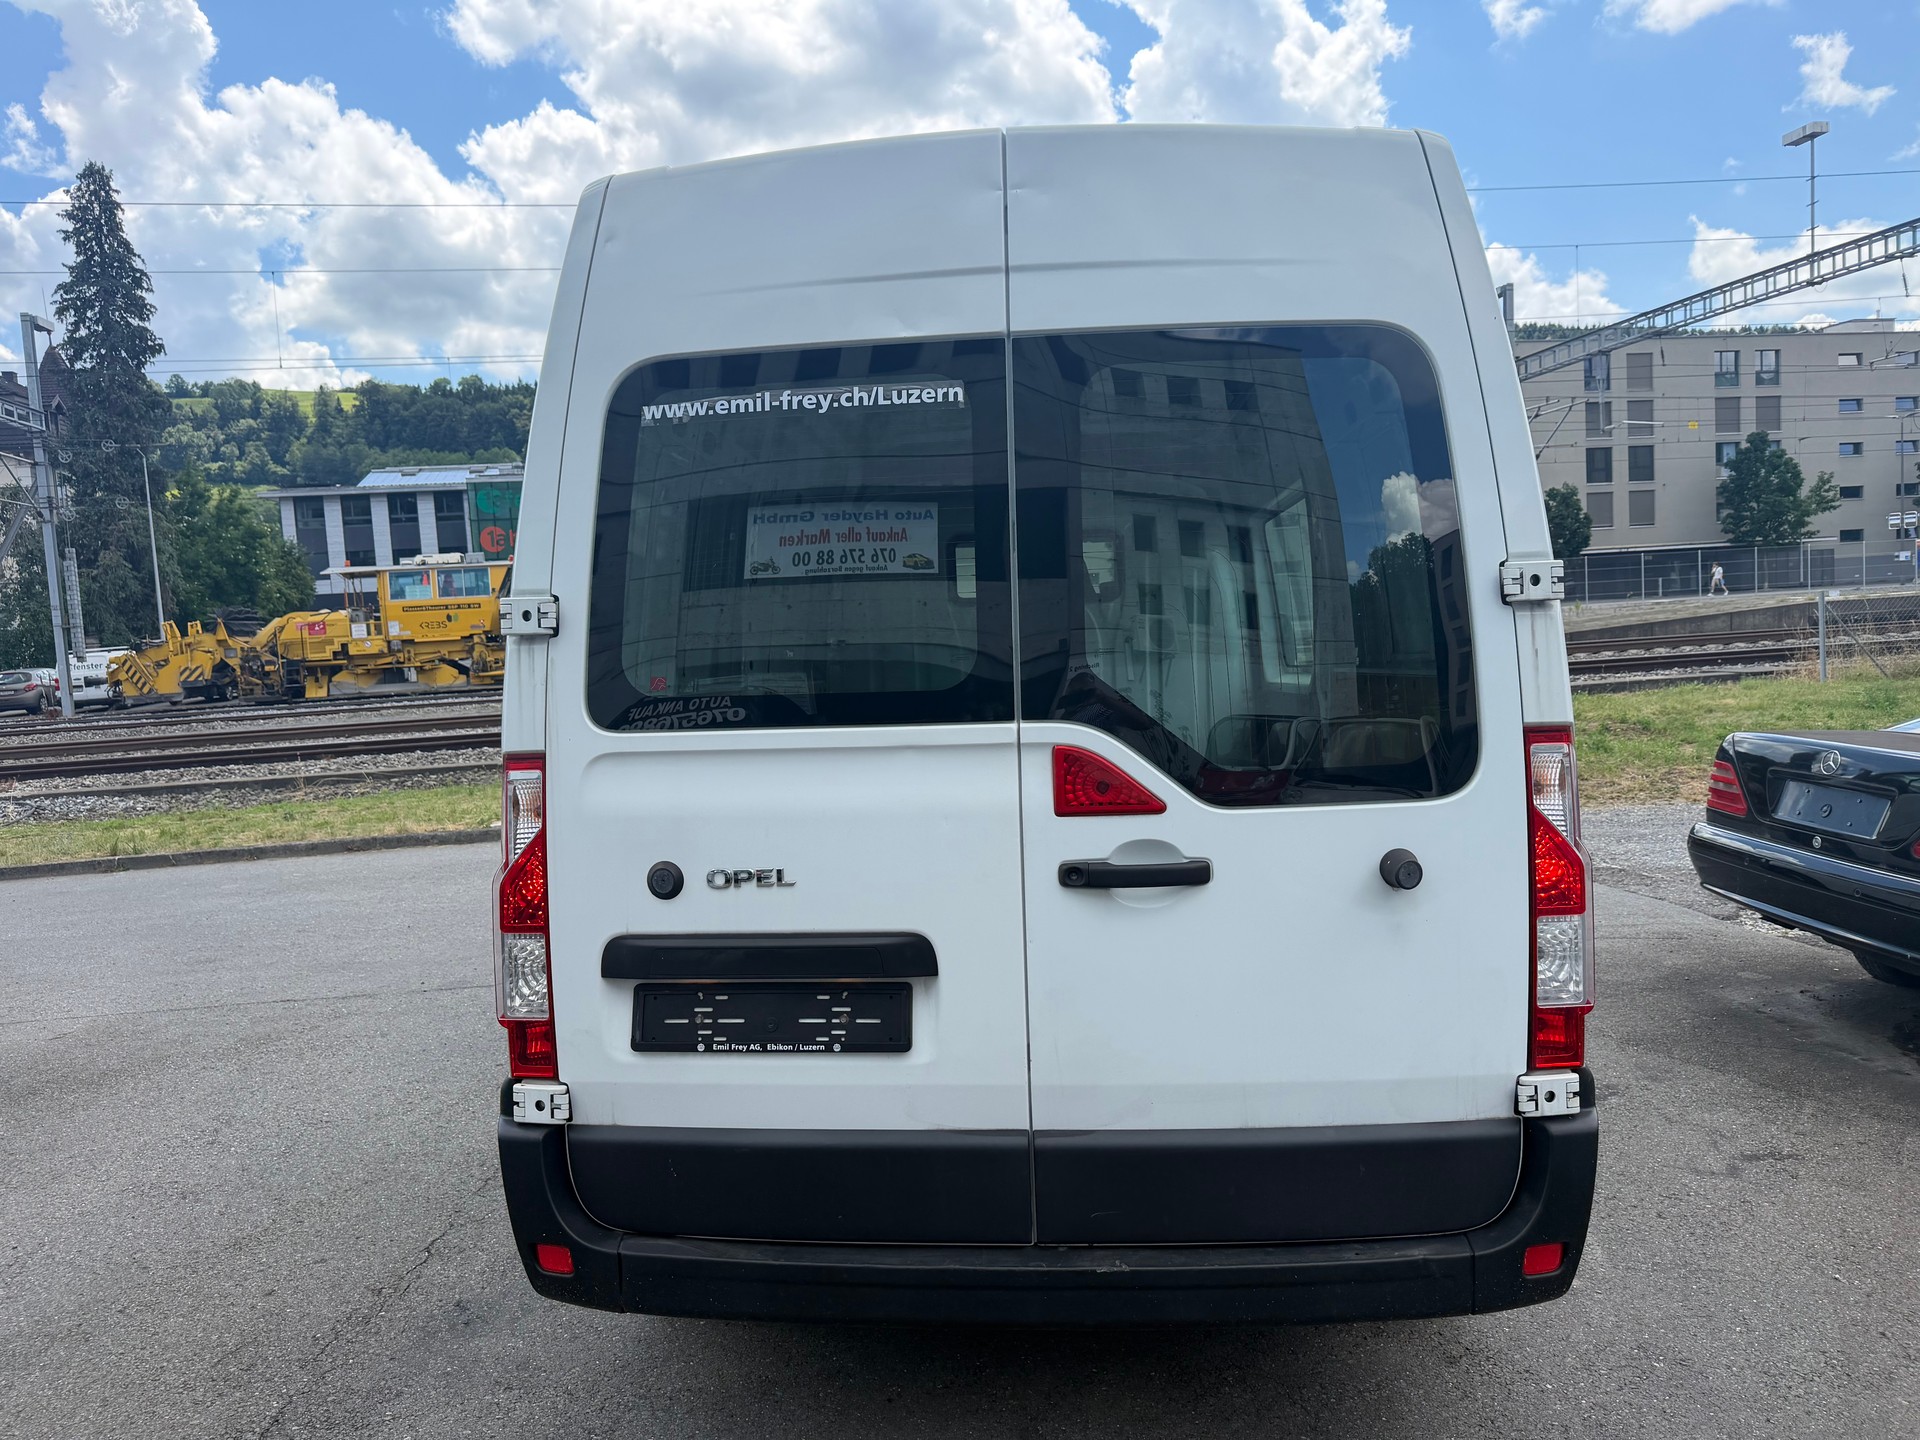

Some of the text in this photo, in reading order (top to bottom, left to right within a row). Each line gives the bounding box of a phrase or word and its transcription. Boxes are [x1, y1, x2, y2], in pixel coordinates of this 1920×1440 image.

[642, 386, 965, 421] www.emil-frey.ch/Luzern
[419, 620, 448, 630] KREBS
[706, 867, 797, 890] OPEL
[712, 1043, 730, 1051] Emil
[731, 1043, 748, 1052] Frey
[749, 1043, 763, 1052] AG,
[767, 1043, 793, 1051] Ebikon
[799, 1043, 825, 1051] Luzern
